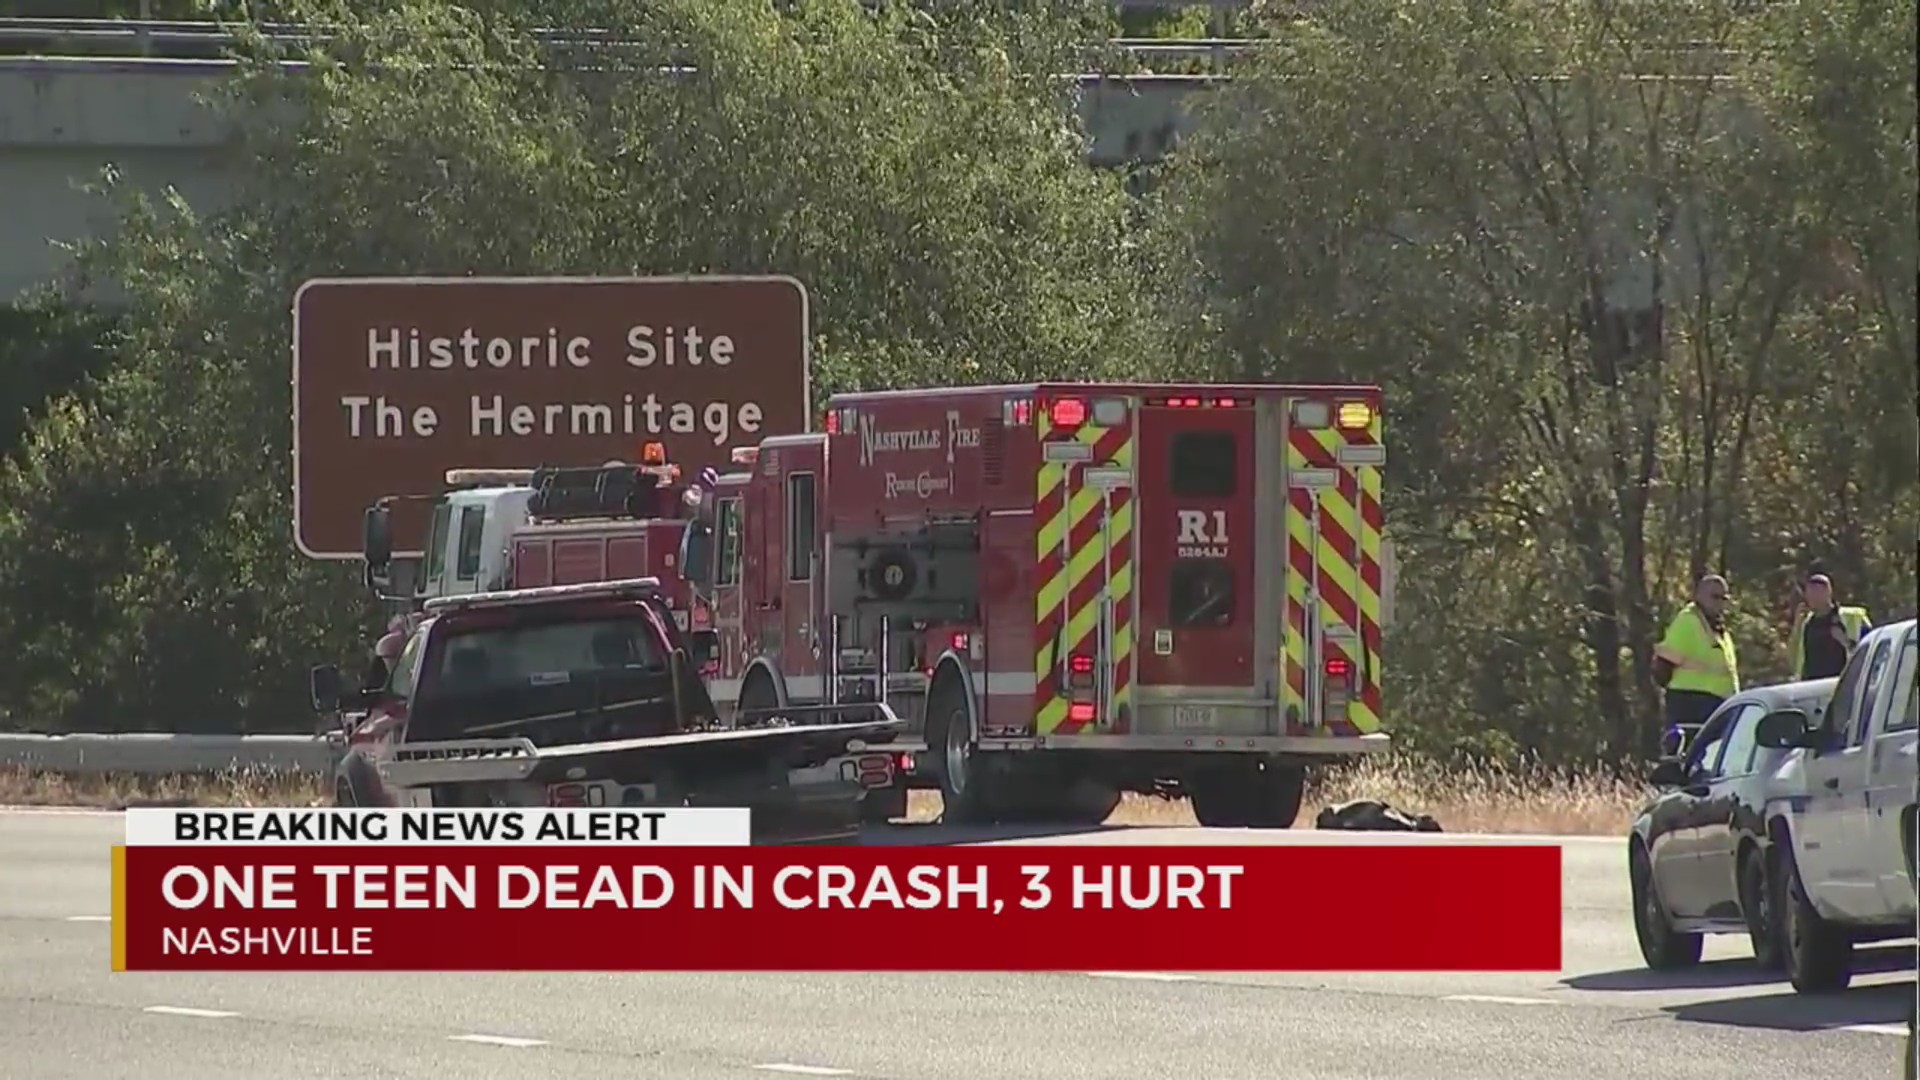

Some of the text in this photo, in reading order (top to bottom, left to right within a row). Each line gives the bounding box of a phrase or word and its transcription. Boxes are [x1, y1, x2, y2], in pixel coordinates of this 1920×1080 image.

[367, 325, 736, 369] Historic Site
[341, 393, 763, 445] The Hermitage
[859, 410, 981, 466] NASHVILLE FIRE
[1177, 509, 1229, 543] R1
